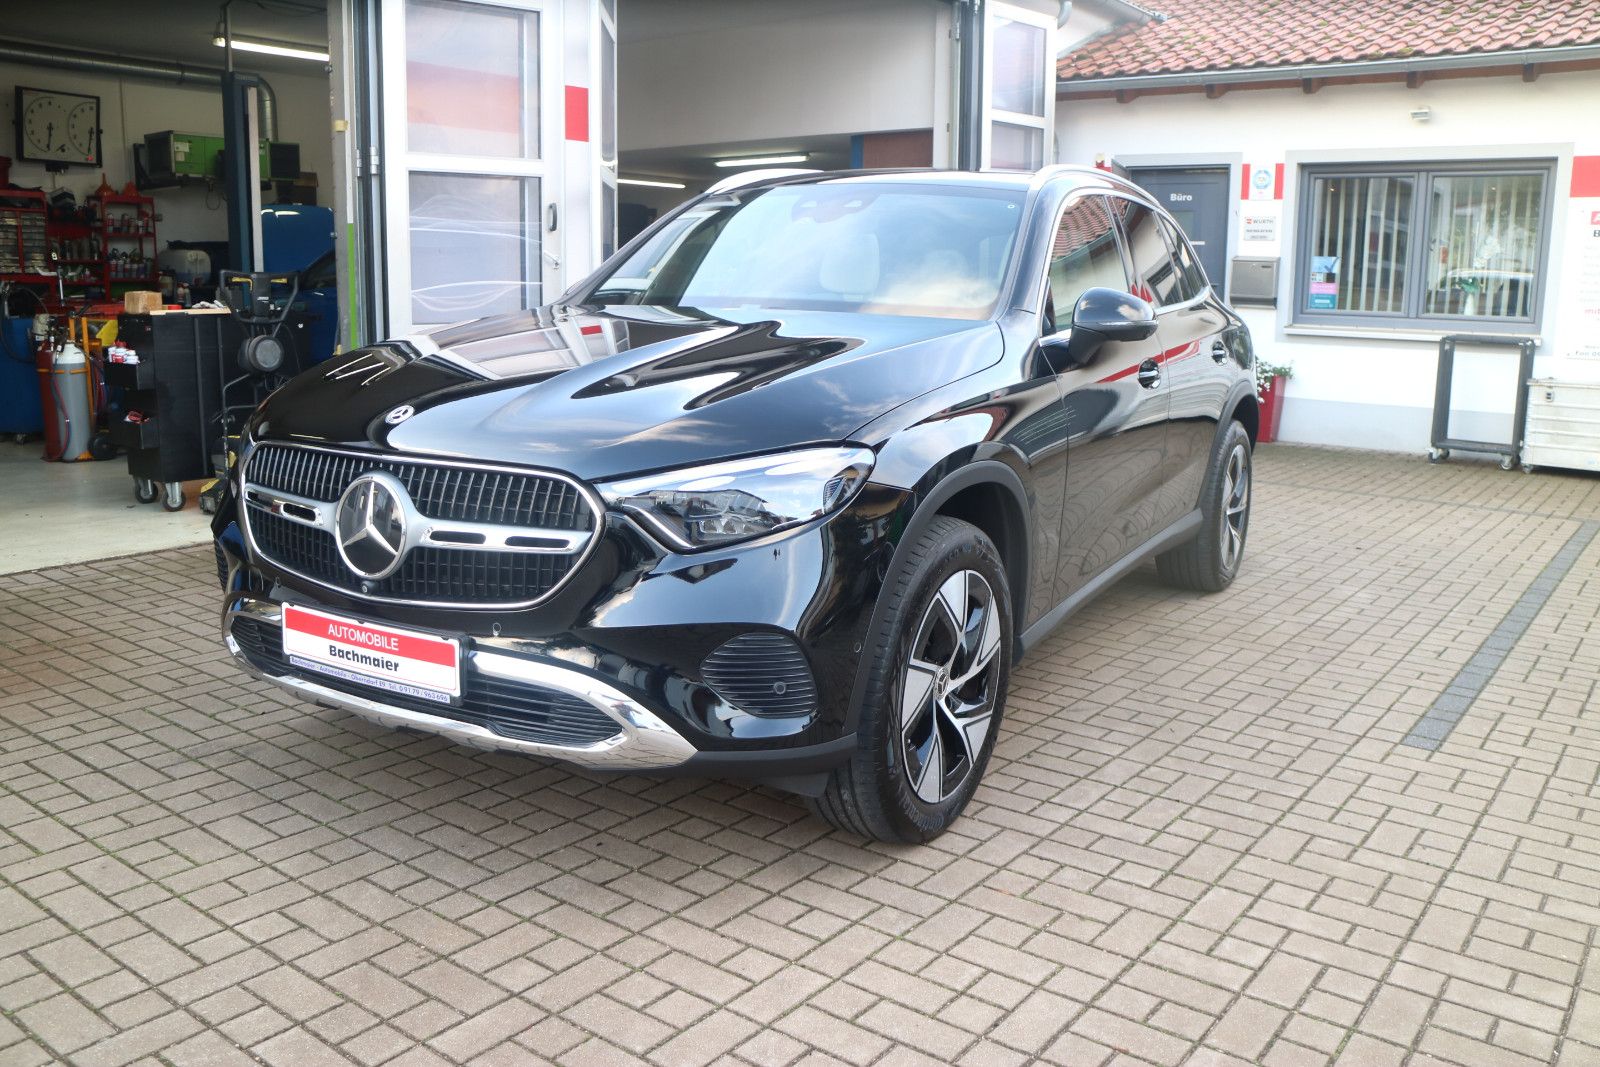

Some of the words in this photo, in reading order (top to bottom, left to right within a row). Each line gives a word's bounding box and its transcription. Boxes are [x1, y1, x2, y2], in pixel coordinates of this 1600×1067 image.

[1170, 193, 1193, 201] Büro
[328, 623, 399, 651] AUTOMOBILE
[329, 645, 399, 672] Bachmaier
